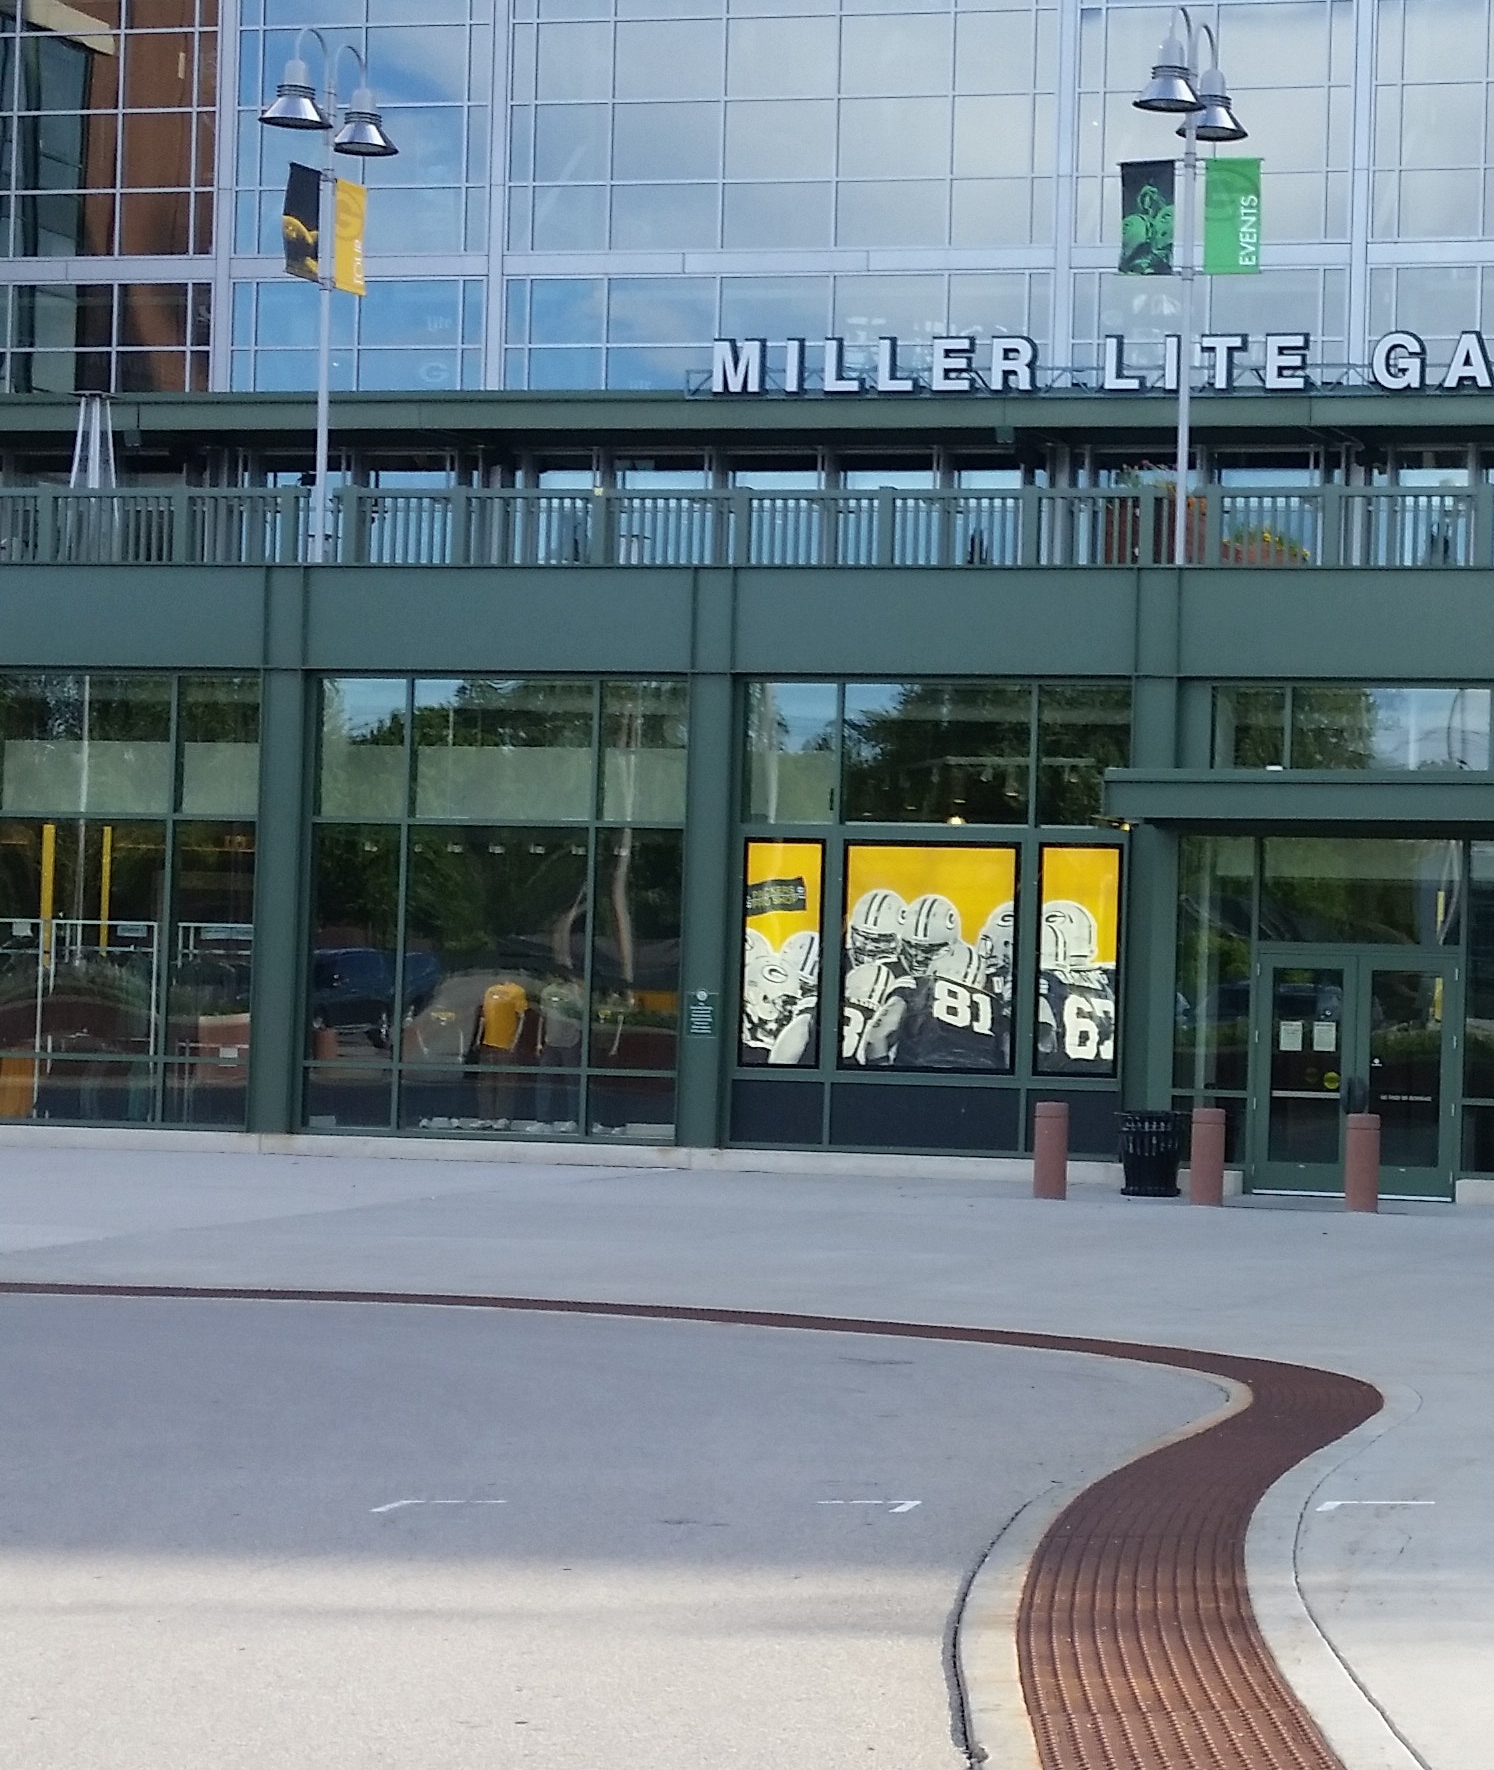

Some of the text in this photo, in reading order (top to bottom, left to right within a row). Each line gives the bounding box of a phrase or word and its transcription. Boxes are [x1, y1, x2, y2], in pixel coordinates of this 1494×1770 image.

[1239, 195, 1258, 266] EVENTS
[710, 334, 1039, 396] MILLER
[1103, 332, 1311, 394] LITE
[933, 980, 995, 1037] 81
